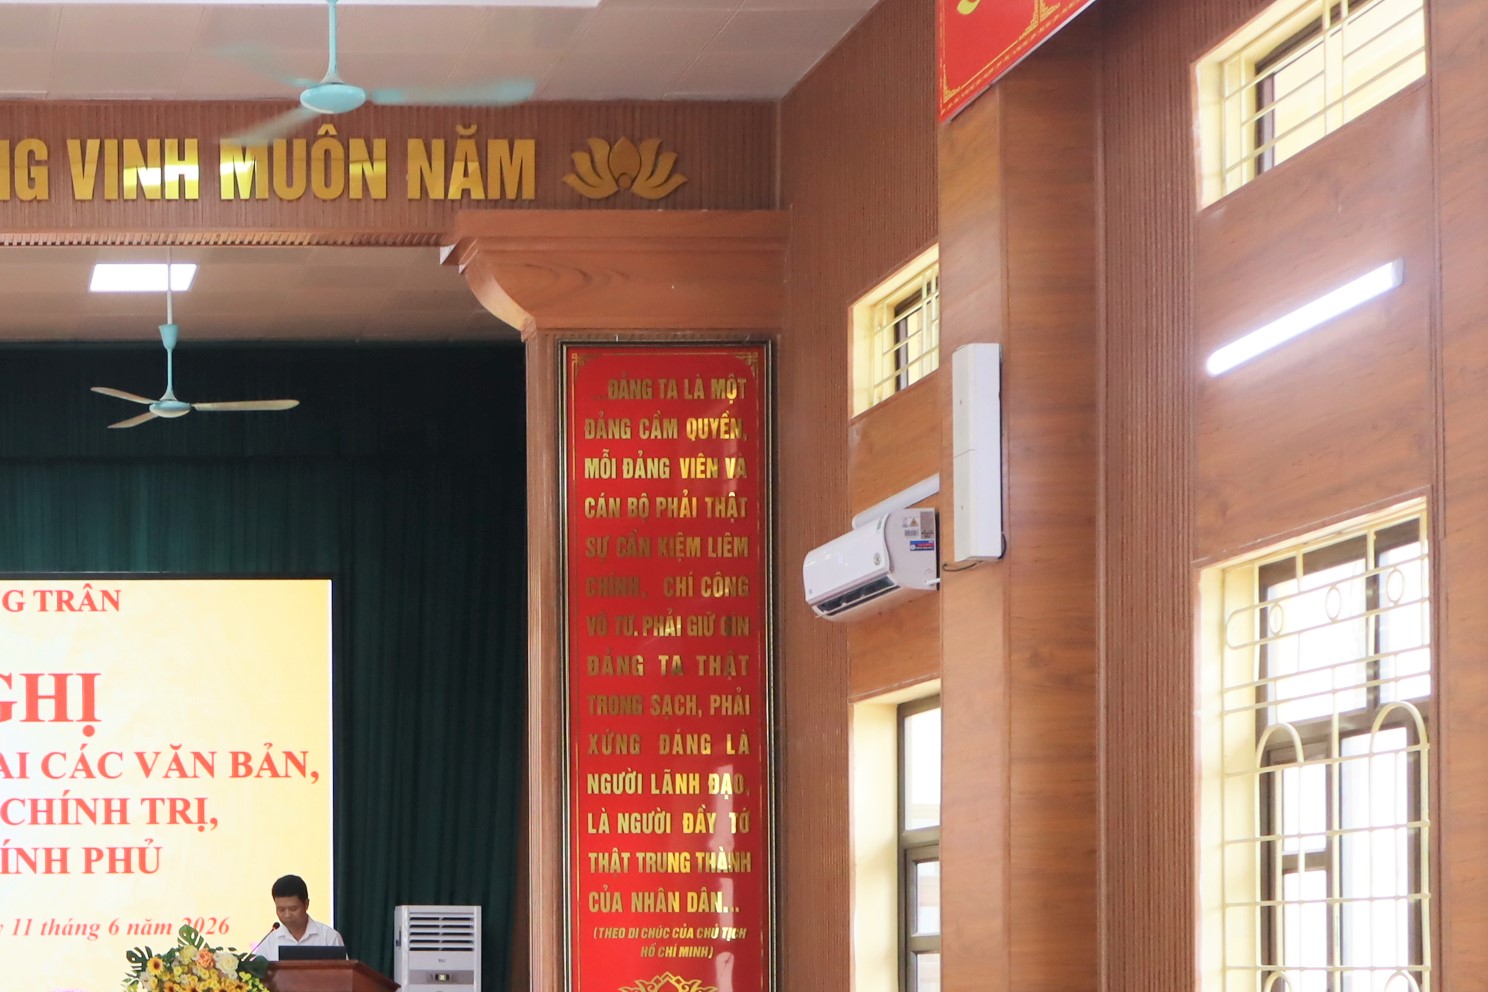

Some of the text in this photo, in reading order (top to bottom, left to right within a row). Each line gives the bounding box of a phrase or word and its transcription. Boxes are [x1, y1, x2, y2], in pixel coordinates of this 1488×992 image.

[67, 138, 200, 201] VINH
[220, 124, 386, 201] MUÔN
[407, 124, 535, 200] NĂM
[658, 379, 678, 399] TA
[684, 374, 704, 399] LÀ
[711, 373, 747, 404] MỘT
[584, 411, 631, 439] ĐẢNG
[639, 409, 678, 439] CẦM
[584, 449, 747, 479] MỖI ĐẢNG VIÊN VÀ
[584, 490, 747, 524] CÁN BỘ PHẢI THẬT
[616, 530, 651, 558] CẦN
[658, 532, 701, 561] KIỆM
[708, 532, 748, 558] LIÊM
[34, 583, 121, 612] TRÂN
[663, 572, 693, 597] CHÍ
[701, 572, 749, 597] CÔNG
[586, 611, 608, 637] VÔ
[643, 608, 681, 637] PHẢI
[687, 612, 715, 637] GIỮ
[587, 648, 749, 682] ĐẢNG TA THẬT
[587, 687, 750, 721] TRONG SẠCH, PHẢI
[588, 728, 750, 755] XỨNG ĐÁNG LÀ
[41, 744, 123, 779] CÁC
[134, 744, 217, 779] VĂN
[229, 742, 319, 783] BẢN,
[587, 768, 643, 794] NGƯỜI
[650, 769, 700, 794] LÃNH
[0, 790, 130, 825] CHÍNH
[141, 797, 218, 832] TRỊ,
[588, 808, 610, 834] LÀ
[618, 808, 671, 834] NGƯỜI
[682, 804, 716, 833] ĐẦY
[82, 839, 162, 874] PHỦ
[588, 847, 751, 878] THẬT TRUNG THÀNH
[588, 885, 740, 913] CỦA NHÂN DÂN...
[11, 918, 31, 936] 11
[41, 918, 100, 940] tháng
[108, 917, 120, 935] 6
[127, 921, 172, 935] năm
[594, 927, 625, 939] (THEO
[641, 924, 670, 938] CHÚC
[672, 923, 694, 938] CỦA
[658, 945, 677, 957] CHÍ
[679, 946, 714, 958] MINH)
